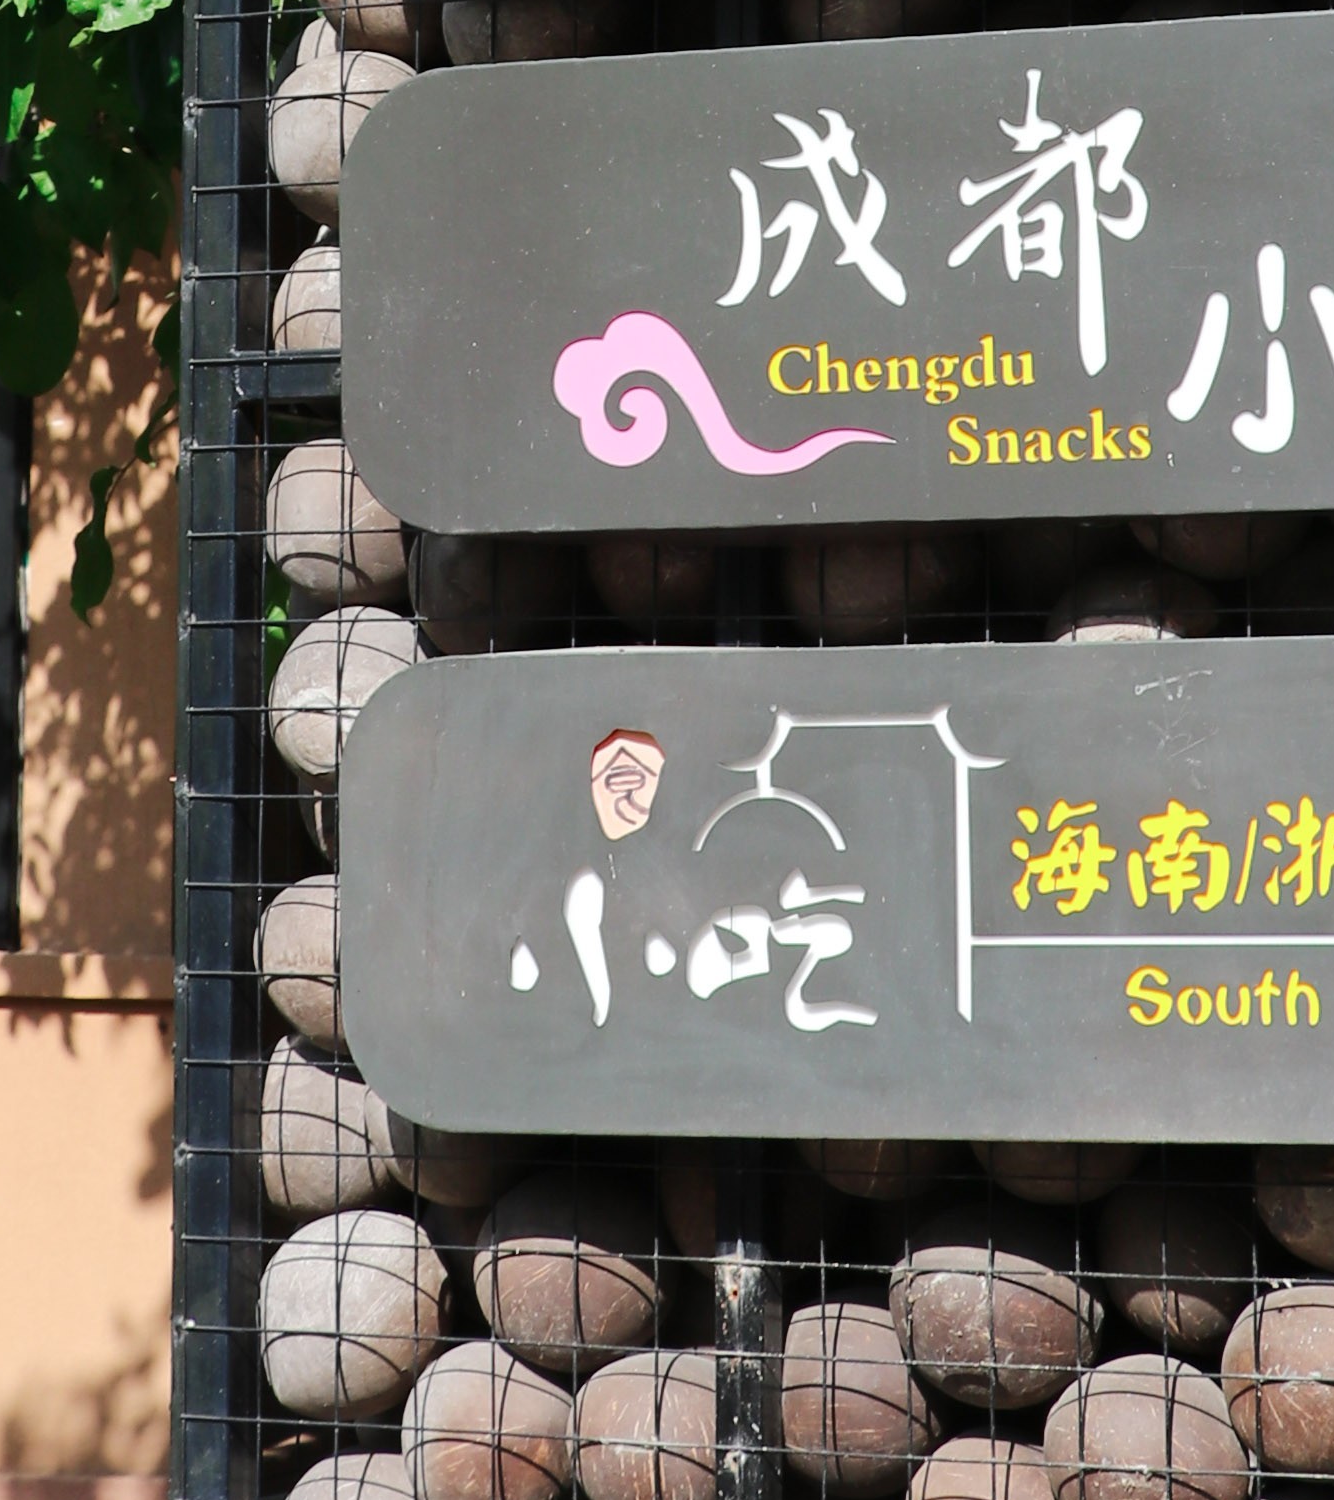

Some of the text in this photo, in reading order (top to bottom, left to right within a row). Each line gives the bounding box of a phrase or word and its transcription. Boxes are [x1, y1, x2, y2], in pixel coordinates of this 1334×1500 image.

[768, 336, 1034, 402] Chengdu
[947, 409, 1152, 465] Snacks
[512, 873, 878, 1030] 小吃
[1127, 967, 1320, 1026] South
